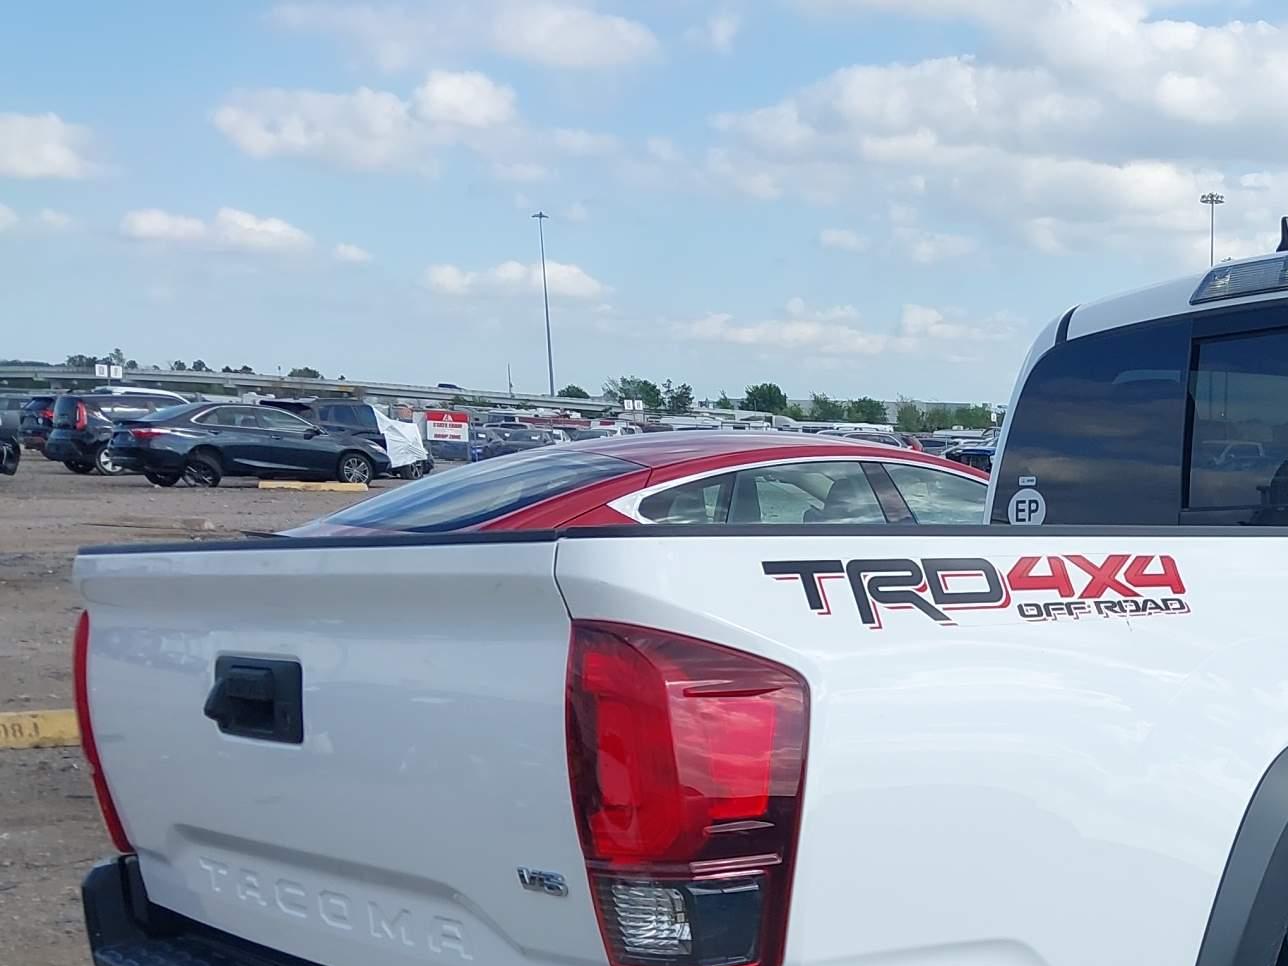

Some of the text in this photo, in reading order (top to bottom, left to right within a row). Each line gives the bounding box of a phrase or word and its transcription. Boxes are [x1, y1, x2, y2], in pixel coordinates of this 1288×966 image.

[1015, 499, 1040, 523] EP
[762, 554, 1187, 629] TRD 4X4
[1017, 598, 1190, 621] OFF ROAD
[517, 865, 569, 897] V6
[199, 857, 473, 961] TACOMA
